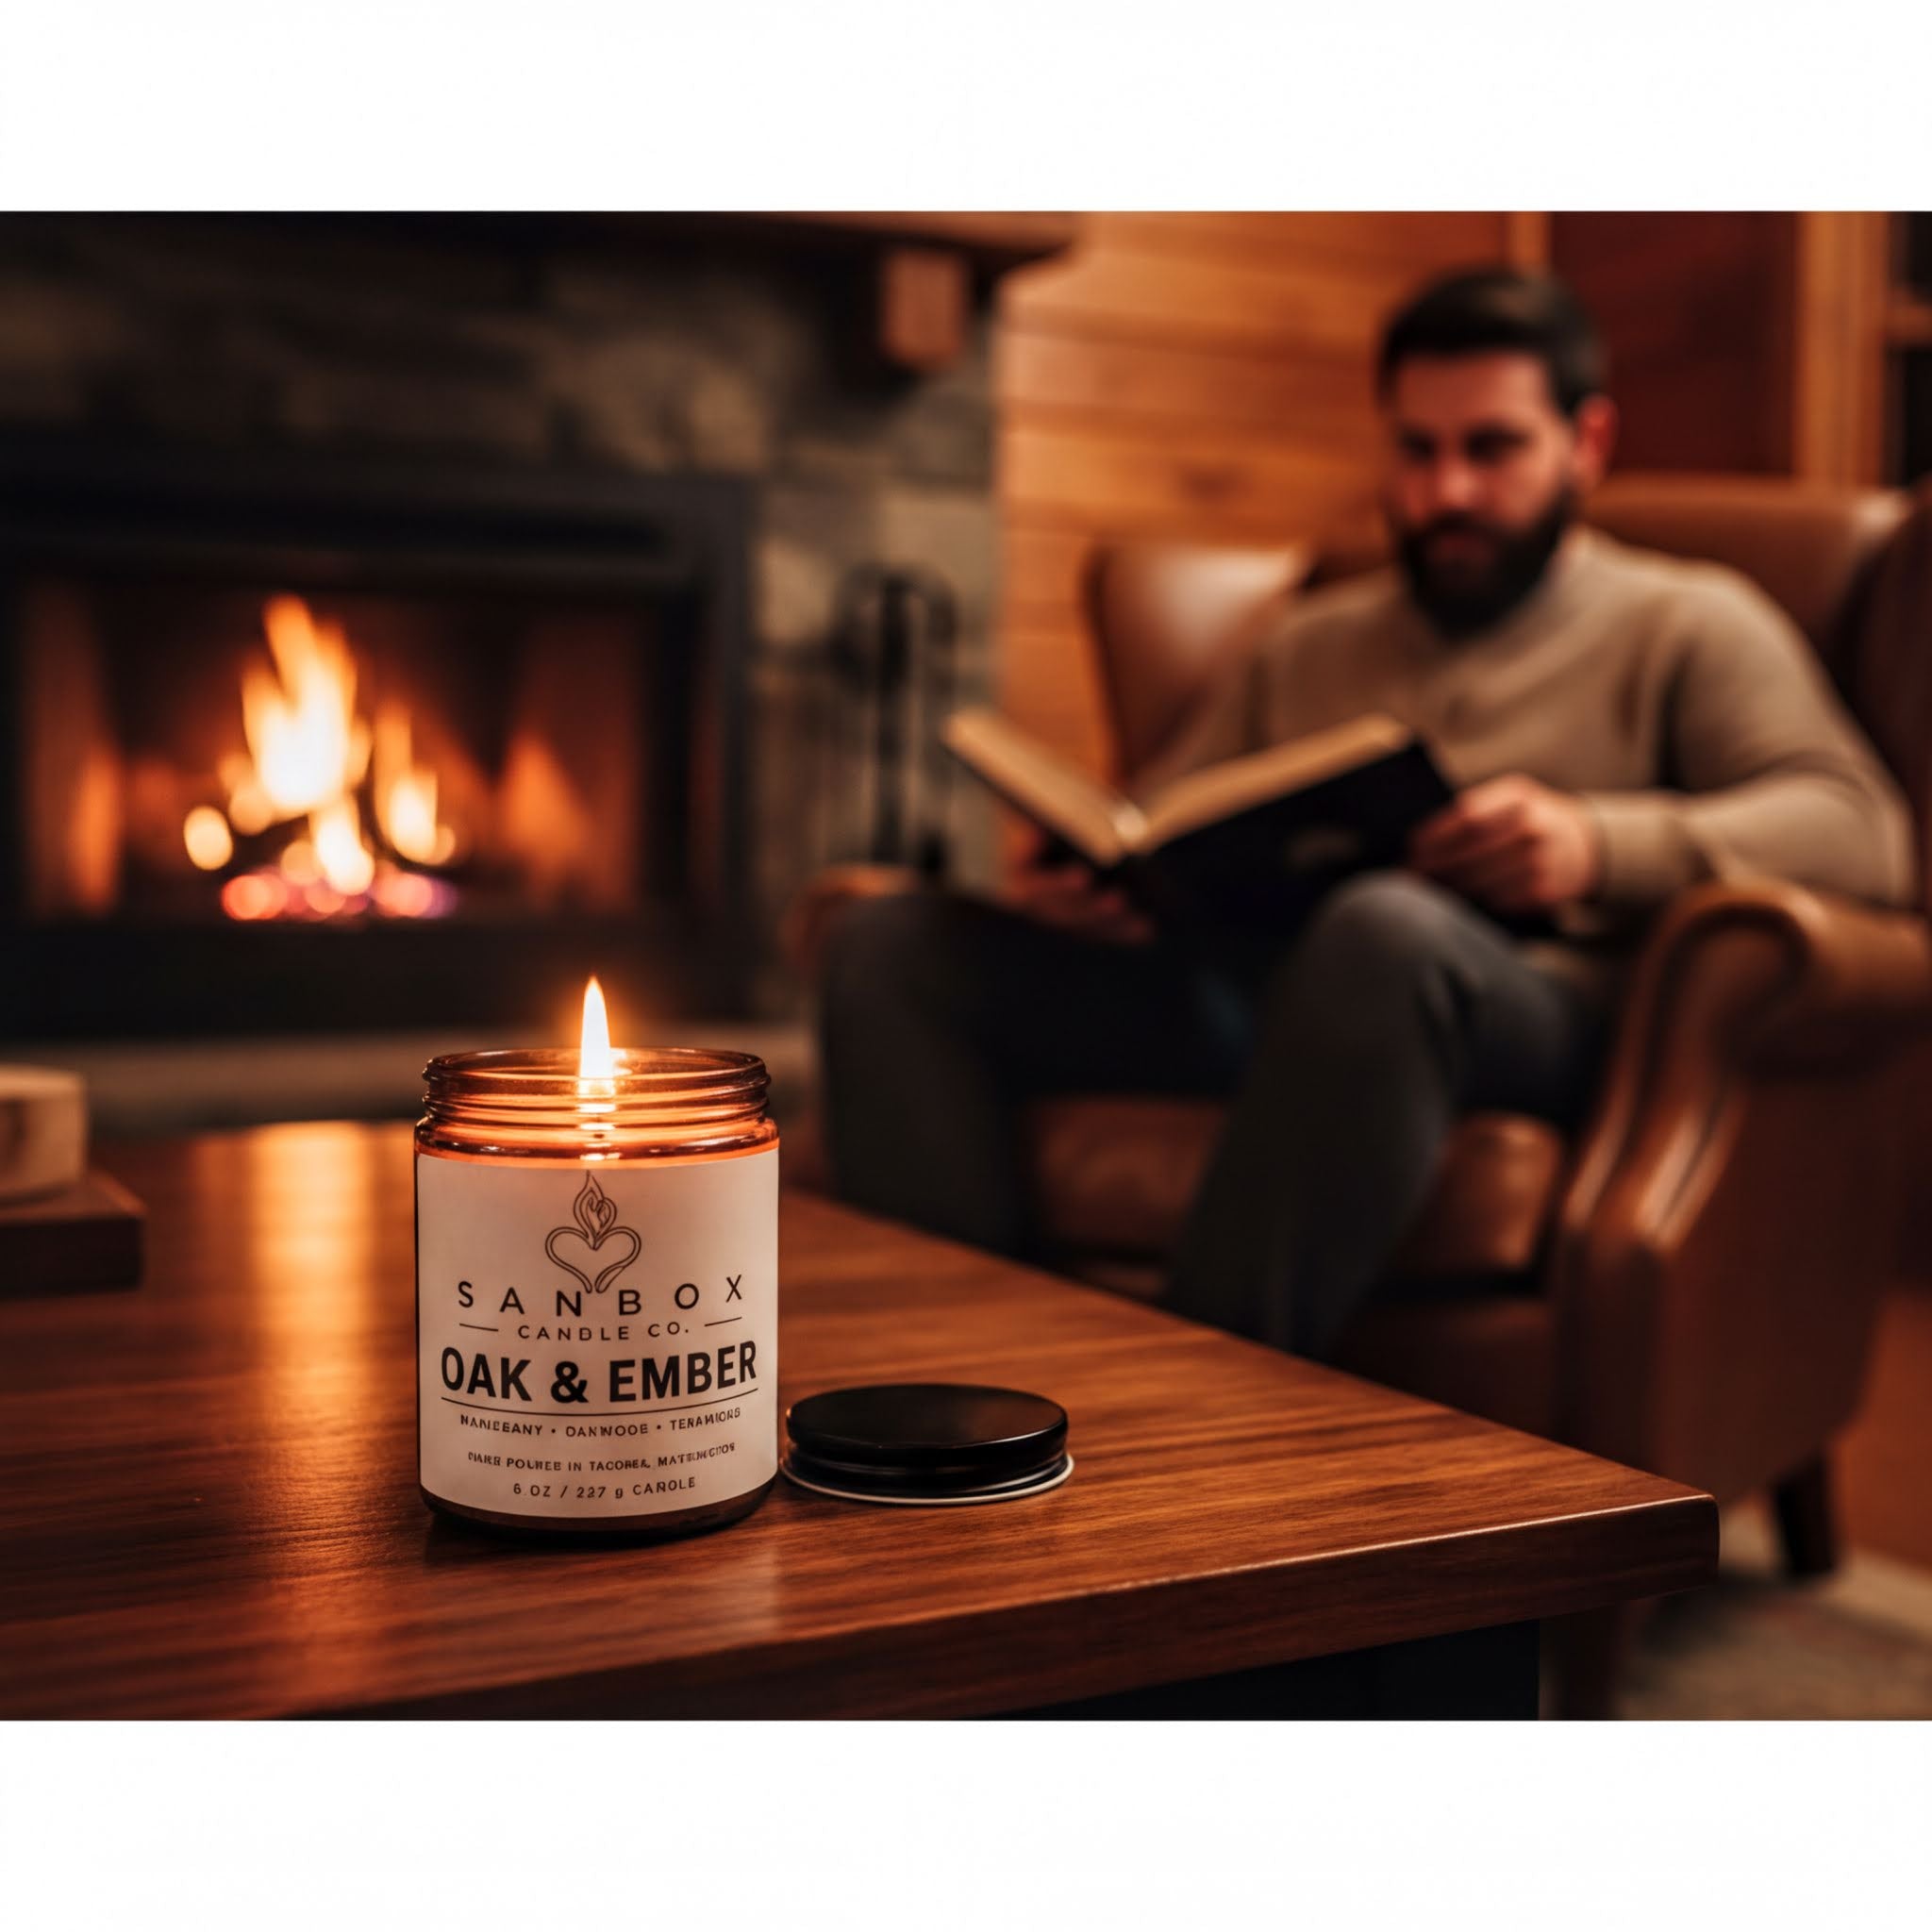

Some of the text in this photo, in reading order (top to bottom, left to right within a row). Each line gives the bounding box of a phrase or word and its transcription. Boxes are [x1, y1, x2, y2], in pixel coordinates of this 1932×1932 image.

[458, 1274, 743, 1317] SANBOX
[518, 1322, 690, 1341] CANDLE CO.
[441, 1340, 758, 1404] OAK & EMBER
[568, 1461, 582, 1472] IN
[513, 1482, 522, 1495] 6
[530, 1485, 551, 1498] OZ
[559, 1485, 569, 1499] /
[576, 1486, 607, 1499] 227
[614, 1488, 624, 1500] g
